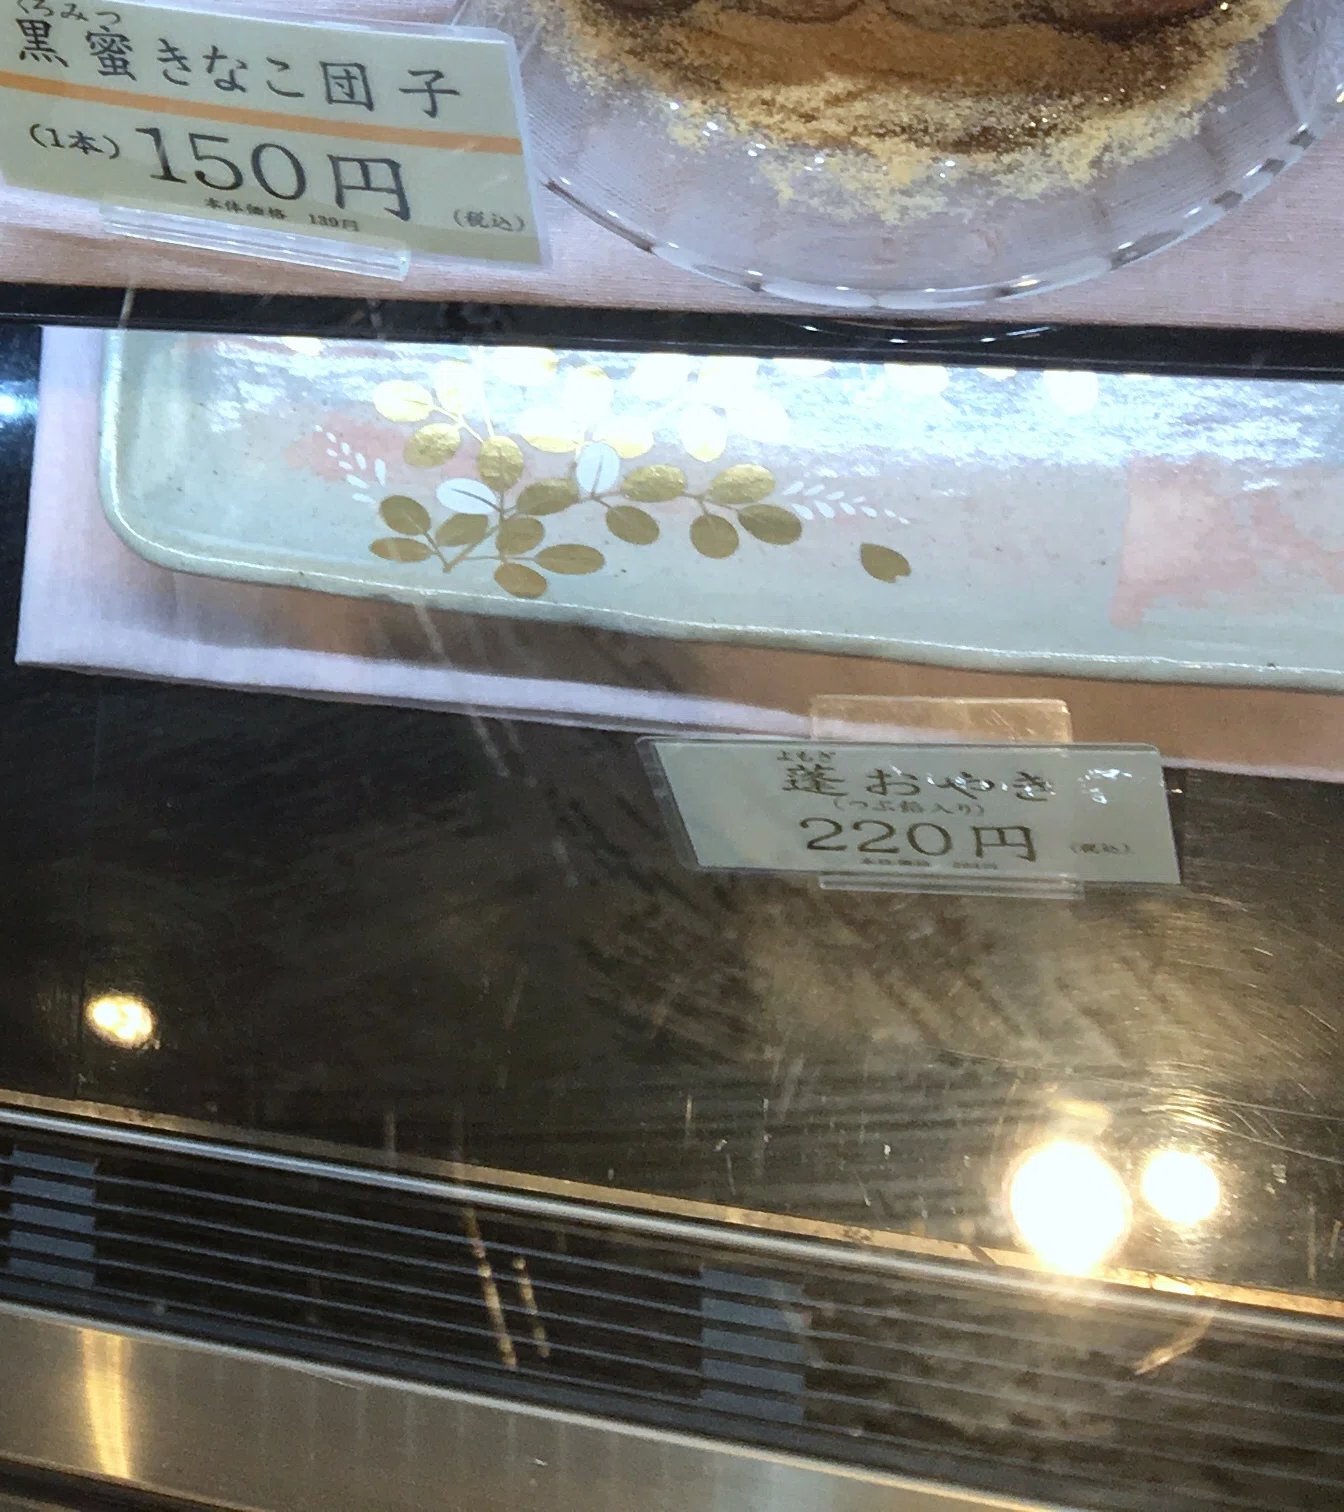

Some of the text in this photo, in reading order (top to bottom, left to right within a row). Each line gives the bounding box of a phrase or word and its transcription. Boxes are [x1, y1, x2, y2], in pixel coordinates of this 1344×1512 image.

[15, 19, 461, 119] 黒蜜きなこ団子
[135, 126, 411, 222] 150円
[799, 817, 1036, 863] 220円
